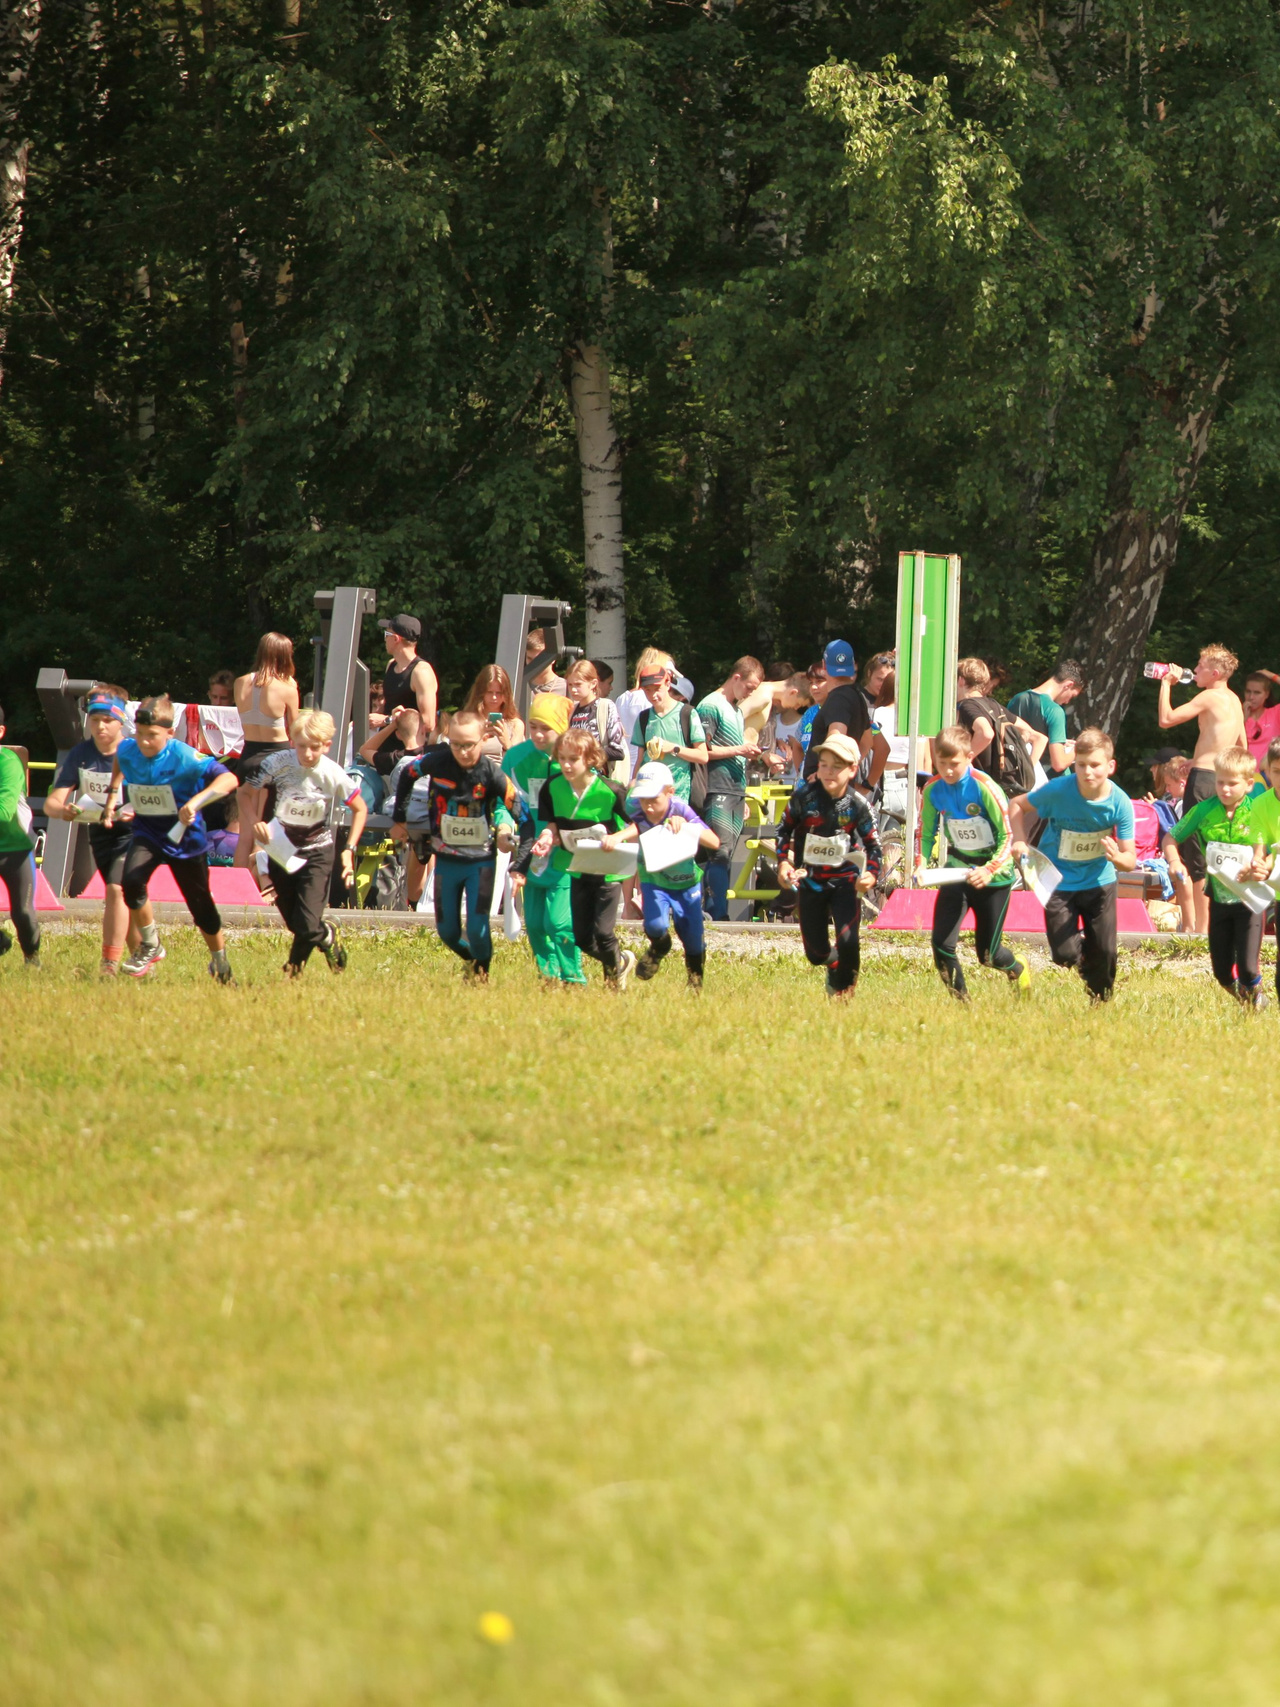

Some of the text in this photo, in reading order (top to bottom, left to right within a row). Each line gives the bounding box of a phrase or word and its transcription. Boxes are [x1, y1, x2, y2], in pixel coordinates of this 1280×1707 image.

[89, 781, 109, 794] 632
[140, 795, 161, 805] 640
[290, 808, 312, 817] 641
[452, 826, 475, 836] 644
[957, 829, 977, 840] 653
[812, 846, 836, 857] 646
[1076, 842, 1097, 852] 647
